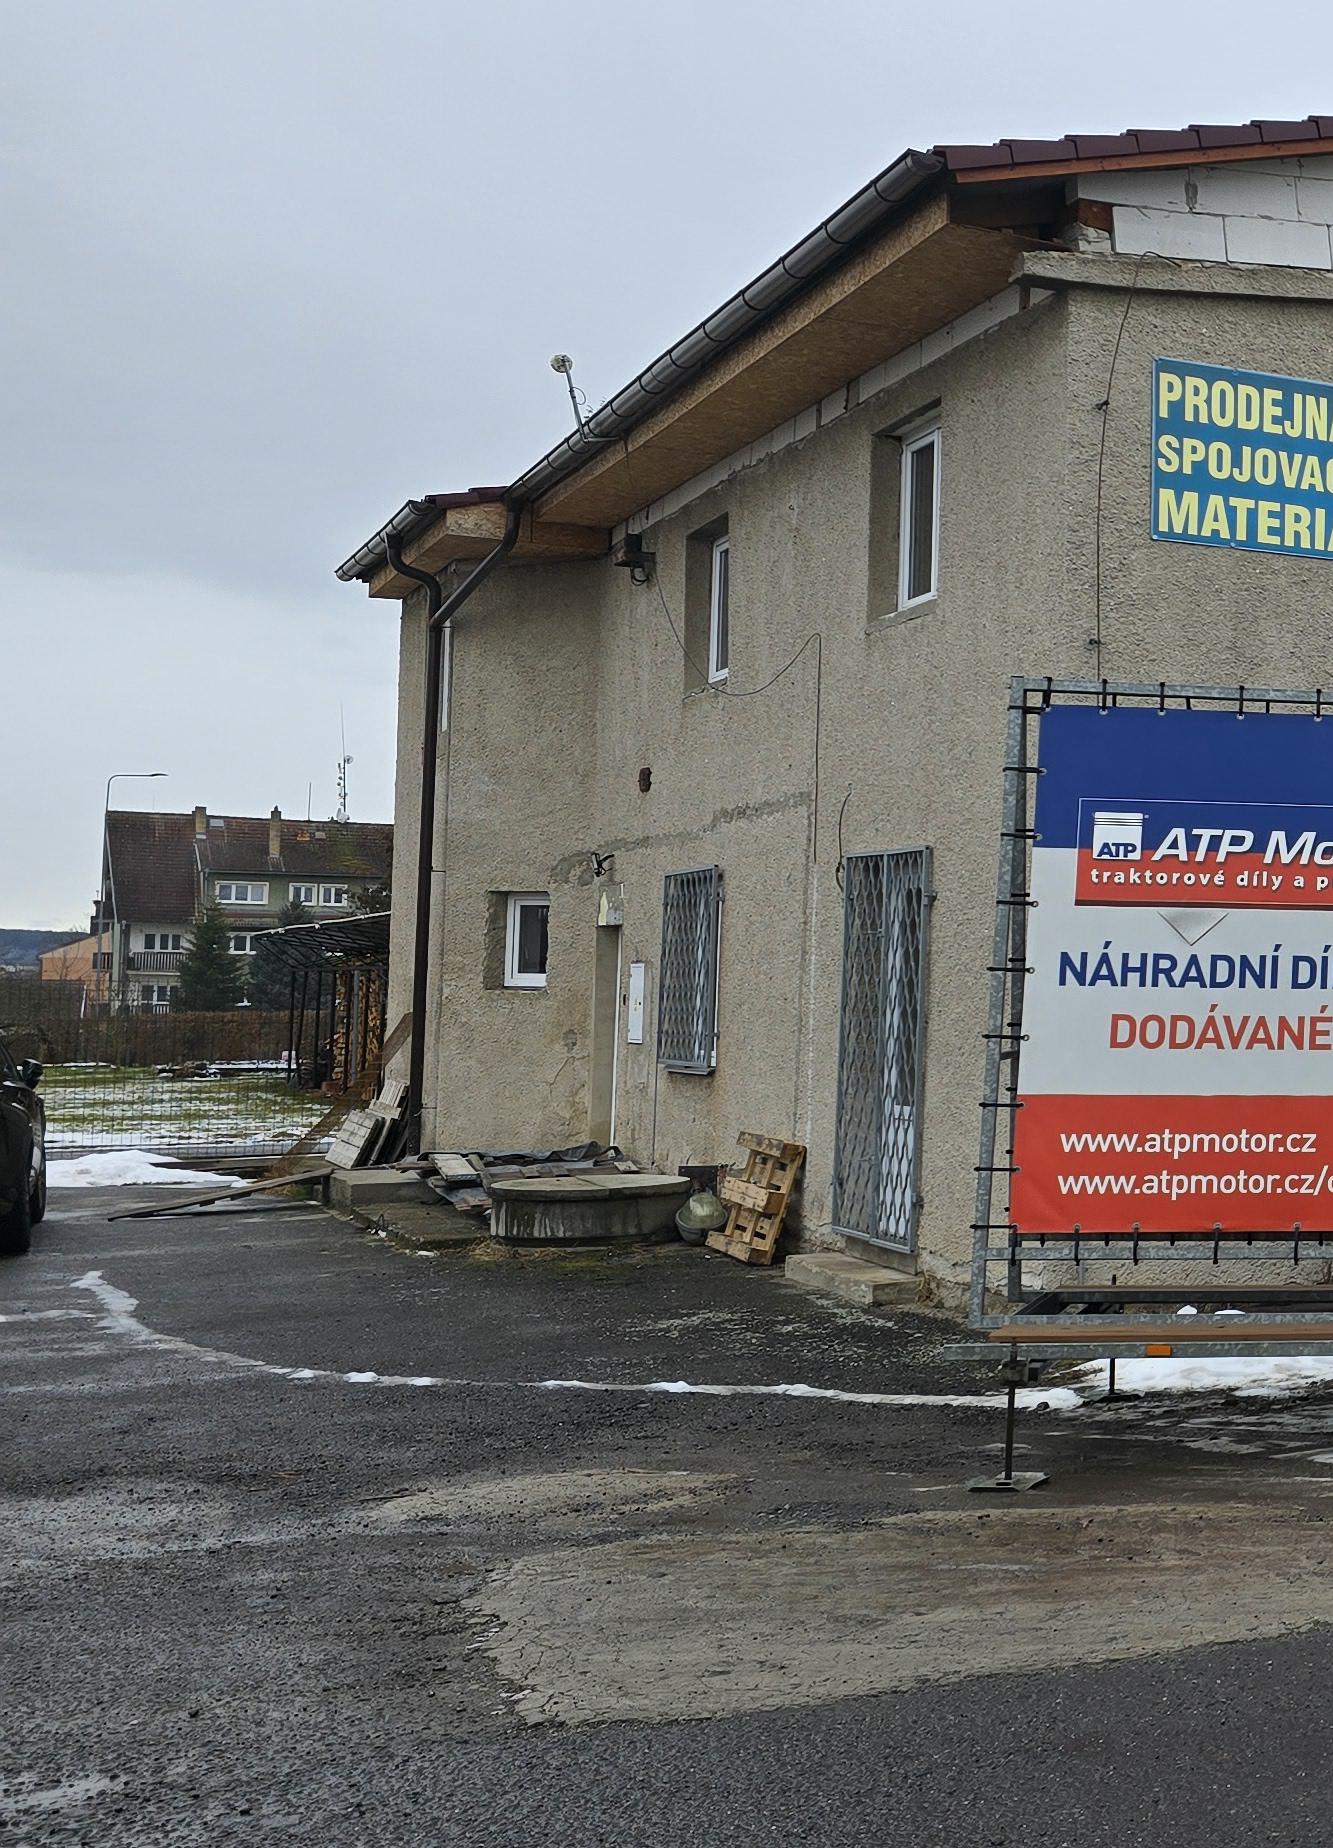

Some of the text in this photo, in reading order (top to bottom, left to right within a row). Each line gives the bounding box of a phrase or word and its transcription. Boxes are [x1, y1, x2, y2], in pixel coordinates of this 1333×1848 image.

[1097, 842, 1138, 858] ATP
[1151, 827, 1255, 862] ATP
[1090, 867, 1225, 885] traktorové
[1236, 870, 1283, 890] díly
[1293, 875, 1305, 888] a
[1058, 940, 1282, 989] NÁHRADNÍ
[1109, 1003, 1333, 1051] DODÁVANÉ
[1059, 1128, 1317, 1160] www.atpmotor.cz
